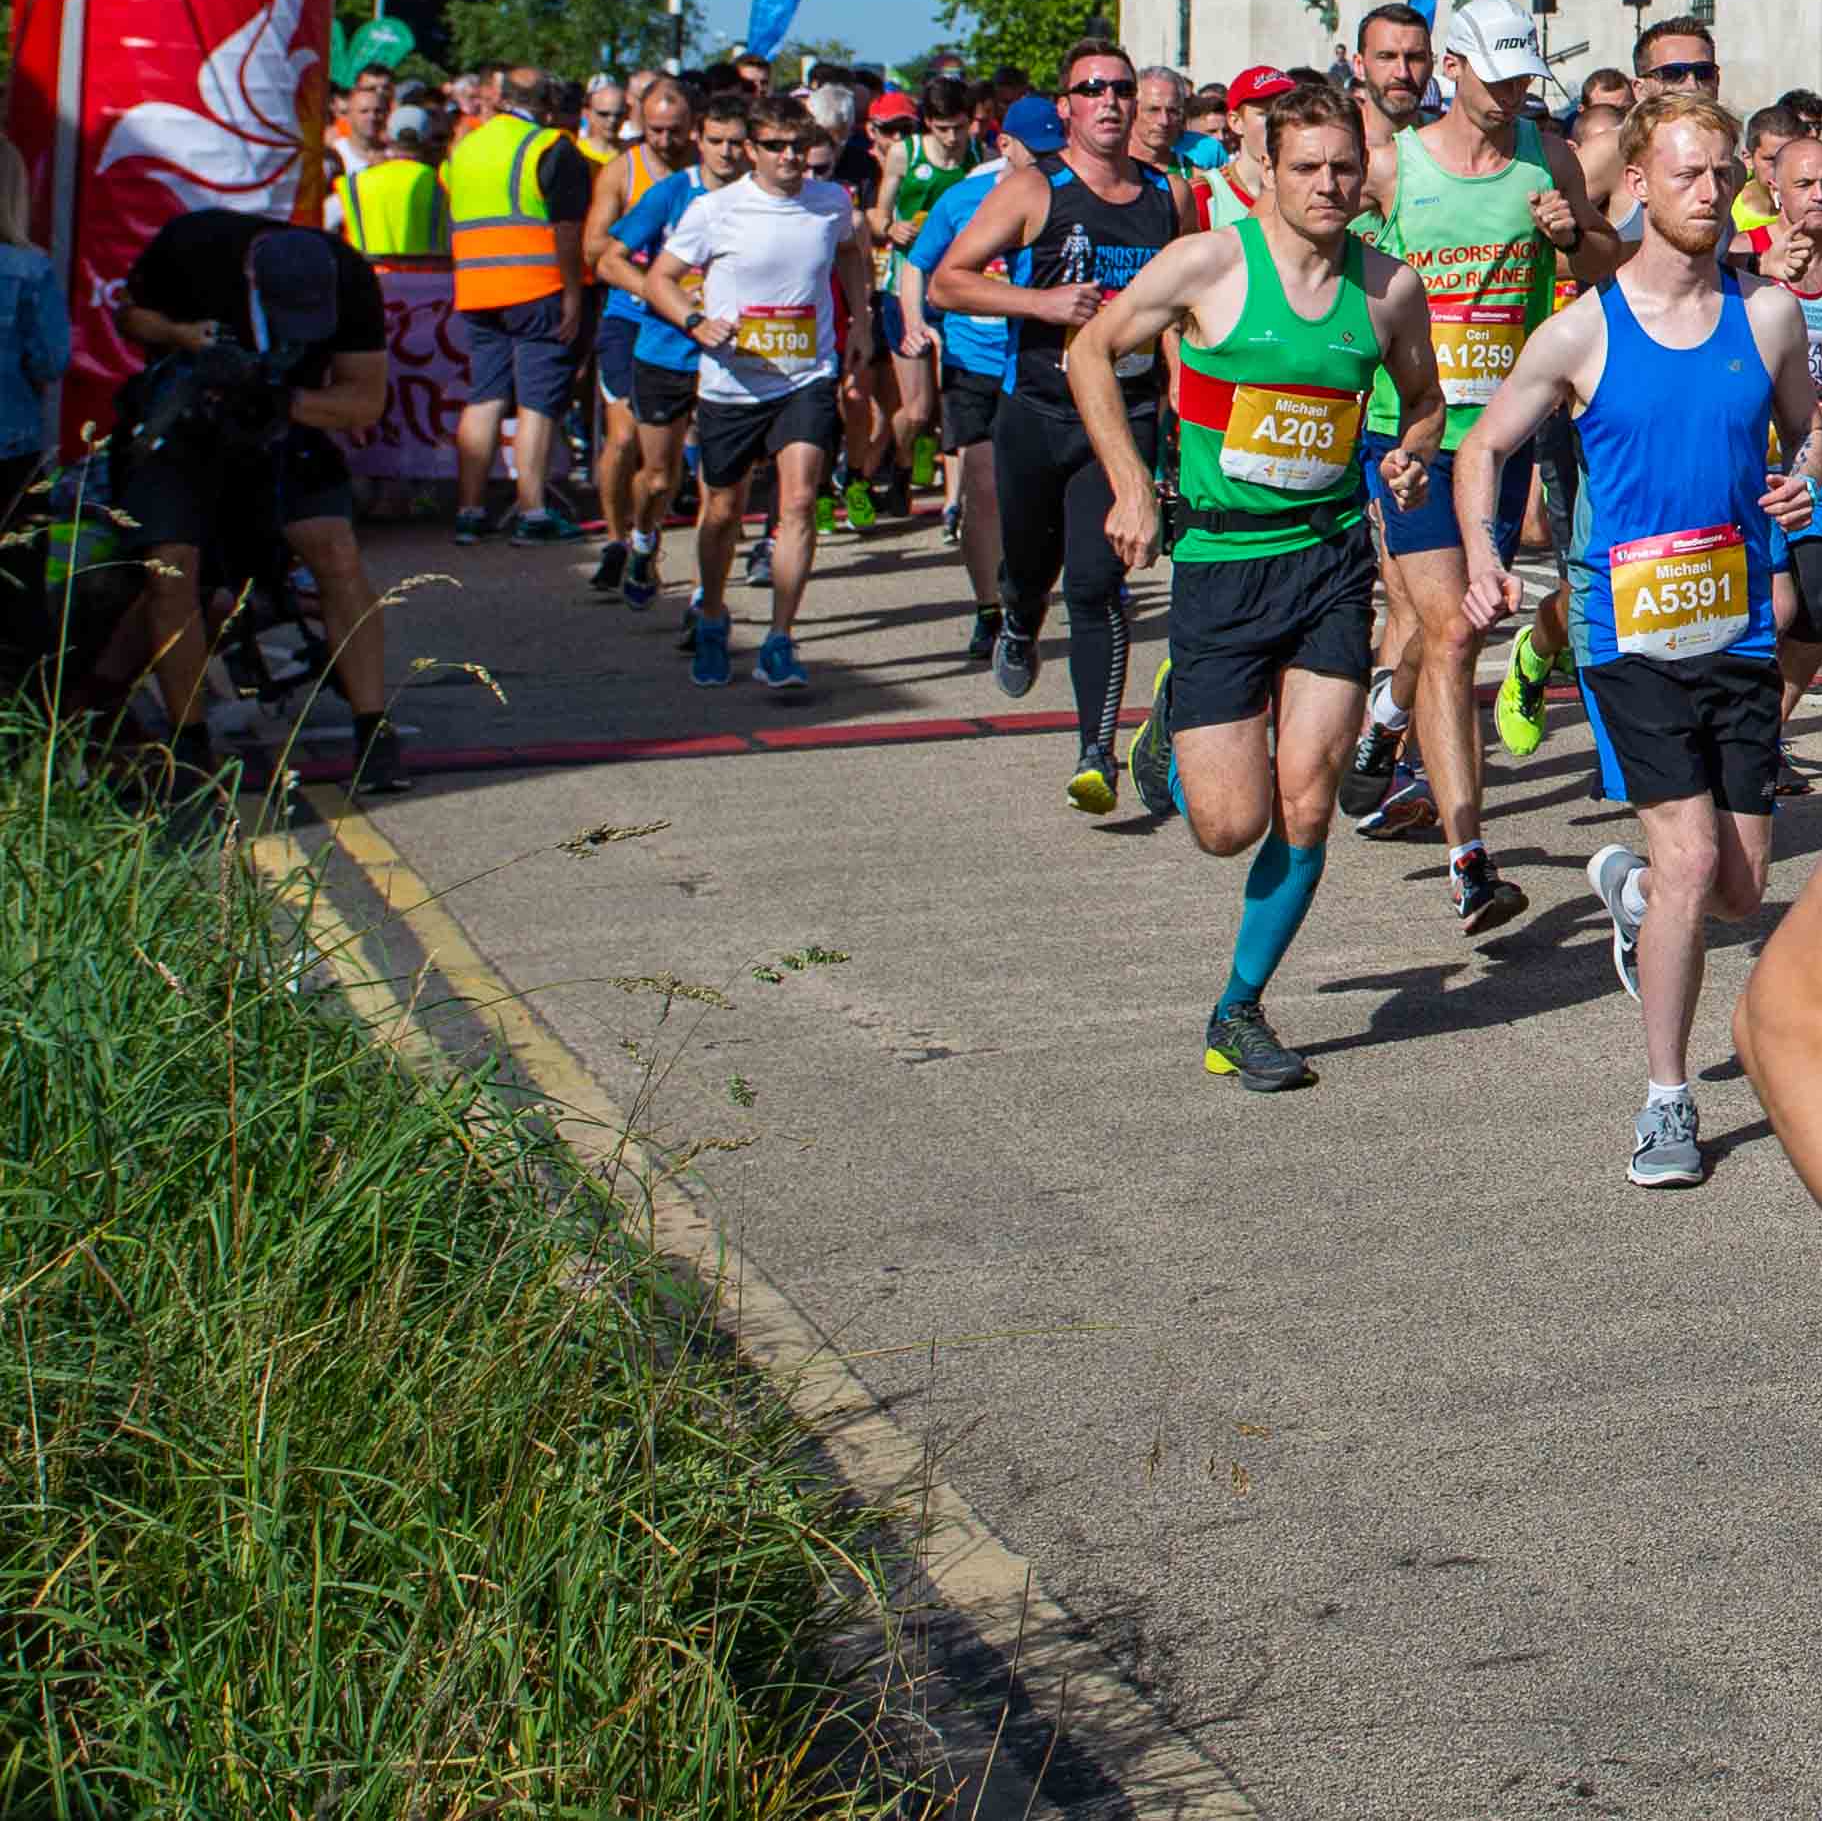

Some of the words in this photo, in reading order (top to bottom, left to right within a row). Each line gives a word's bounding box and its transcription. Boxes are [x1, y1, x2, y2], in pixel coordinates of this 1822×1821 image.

[1096, 244, 1161, 268] PROSTA
[1093, 267, 1142, 291] CANC
[1424, 273, 1462, 291] OAD
[1465, 267, 1537, 289] RUNNER
[747, 333, 809, 351] A3190
[1436, 344, 1515, 368] A1259
[1275, 399, 1329, 418] Michael
[1251, 414, 1335, 450] A203
[1655, 558, 1713, 579] Michael
[1631, 572, 1732, 619] A5391
